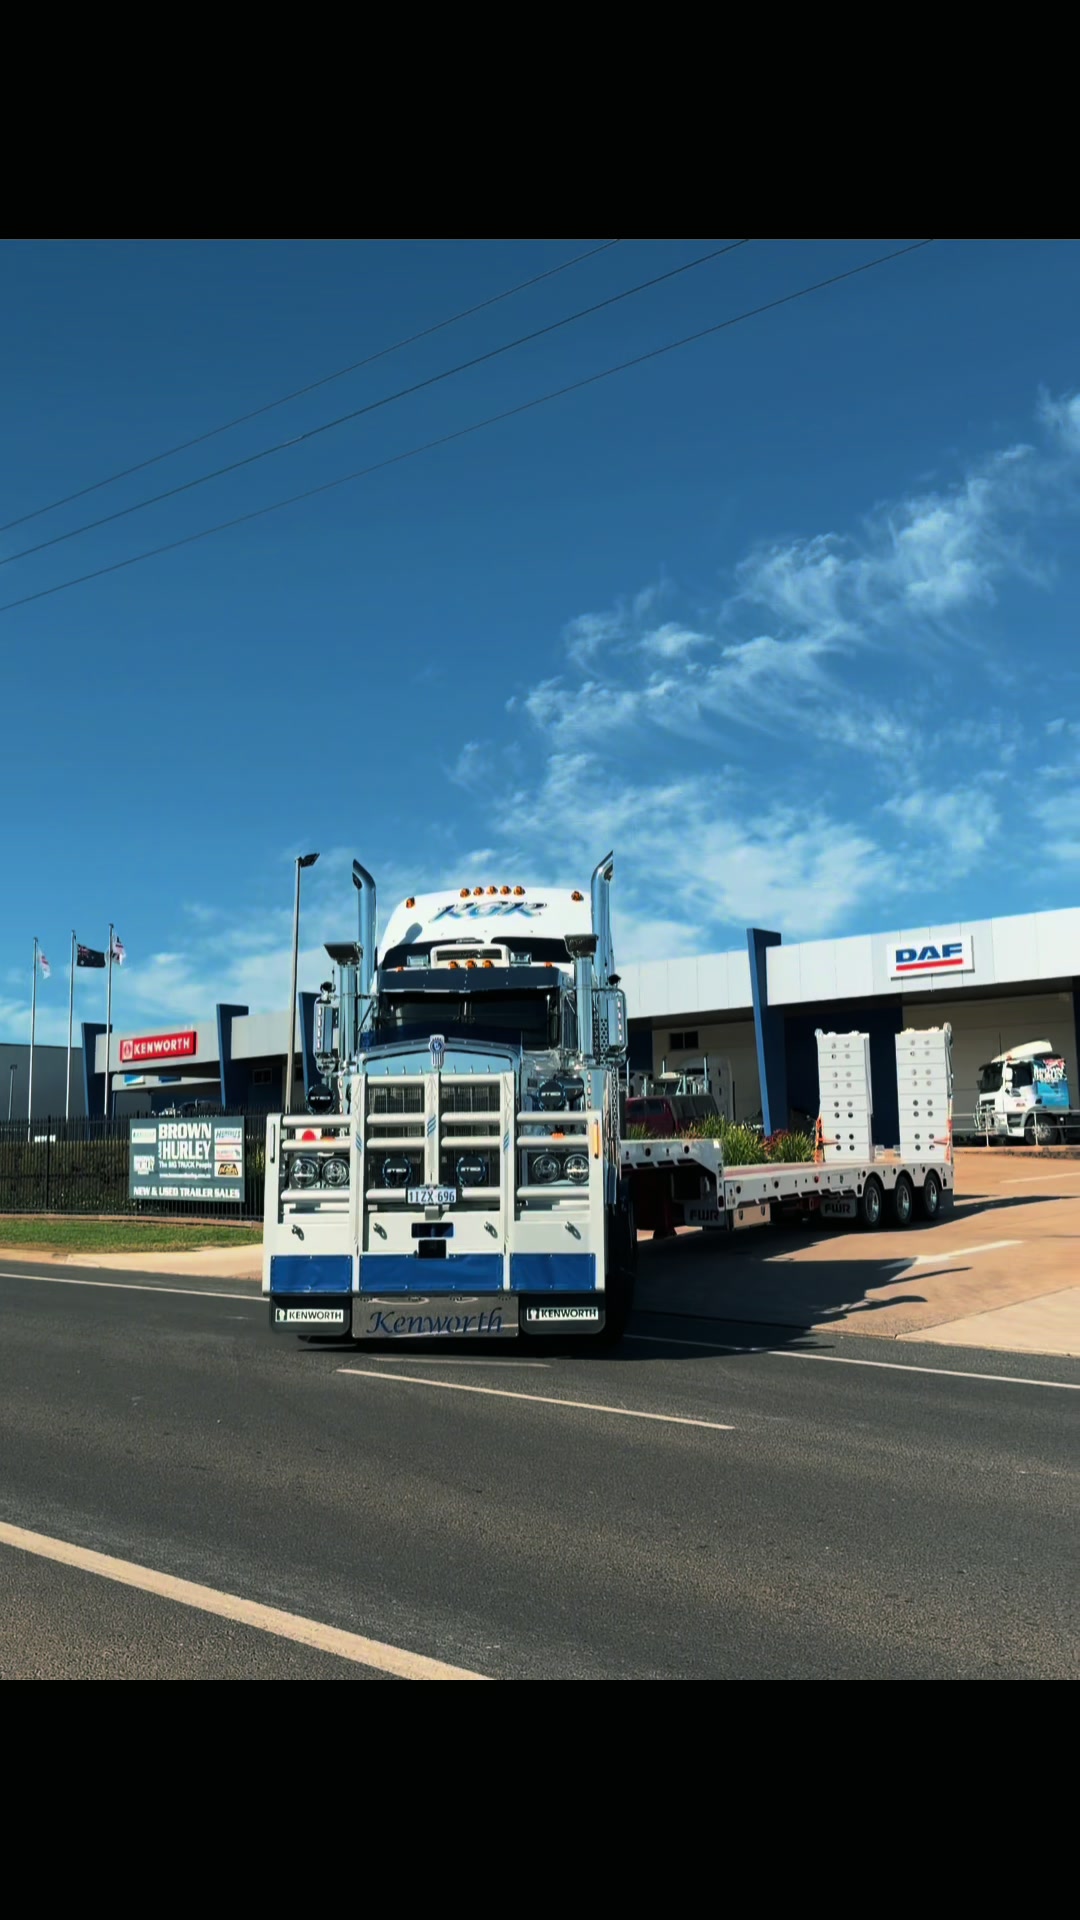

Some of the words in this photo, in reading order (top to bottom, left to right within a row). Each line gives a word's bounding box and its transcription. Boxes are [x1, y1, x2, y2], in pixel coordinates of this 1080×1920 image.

[895, 942, 962, 963] DAF
[134, 1037, 190, 1056] KENWORTH
[158, 1123, 212, 1139] BROWN
[163, 1140, 211, 1160] HURLEY
[159, 1161, 168, 1169] The
[178, 1161, 195, 1169] TRUCK
[195, 1161, 212, 1170] People
[134, 1186, 150, 1196] NEW
[151, 1187, 158, 1196] &
[159, 1187, 179, 1197] USED
[180, 1187, 213, 1197] TRAILER
[214, 1188, 240, 1199] SALES
[437, 1191, 455, 1202] 696
[824, 1203, 851, 1214] FWR
[690, 1209, 719, 1222] FWR
[288, 1310, 342, 1320] KENWORTH
[541, 1308, 597, 1319] KENWORTH
[366, 1307, 504, 1334] Kenworth
